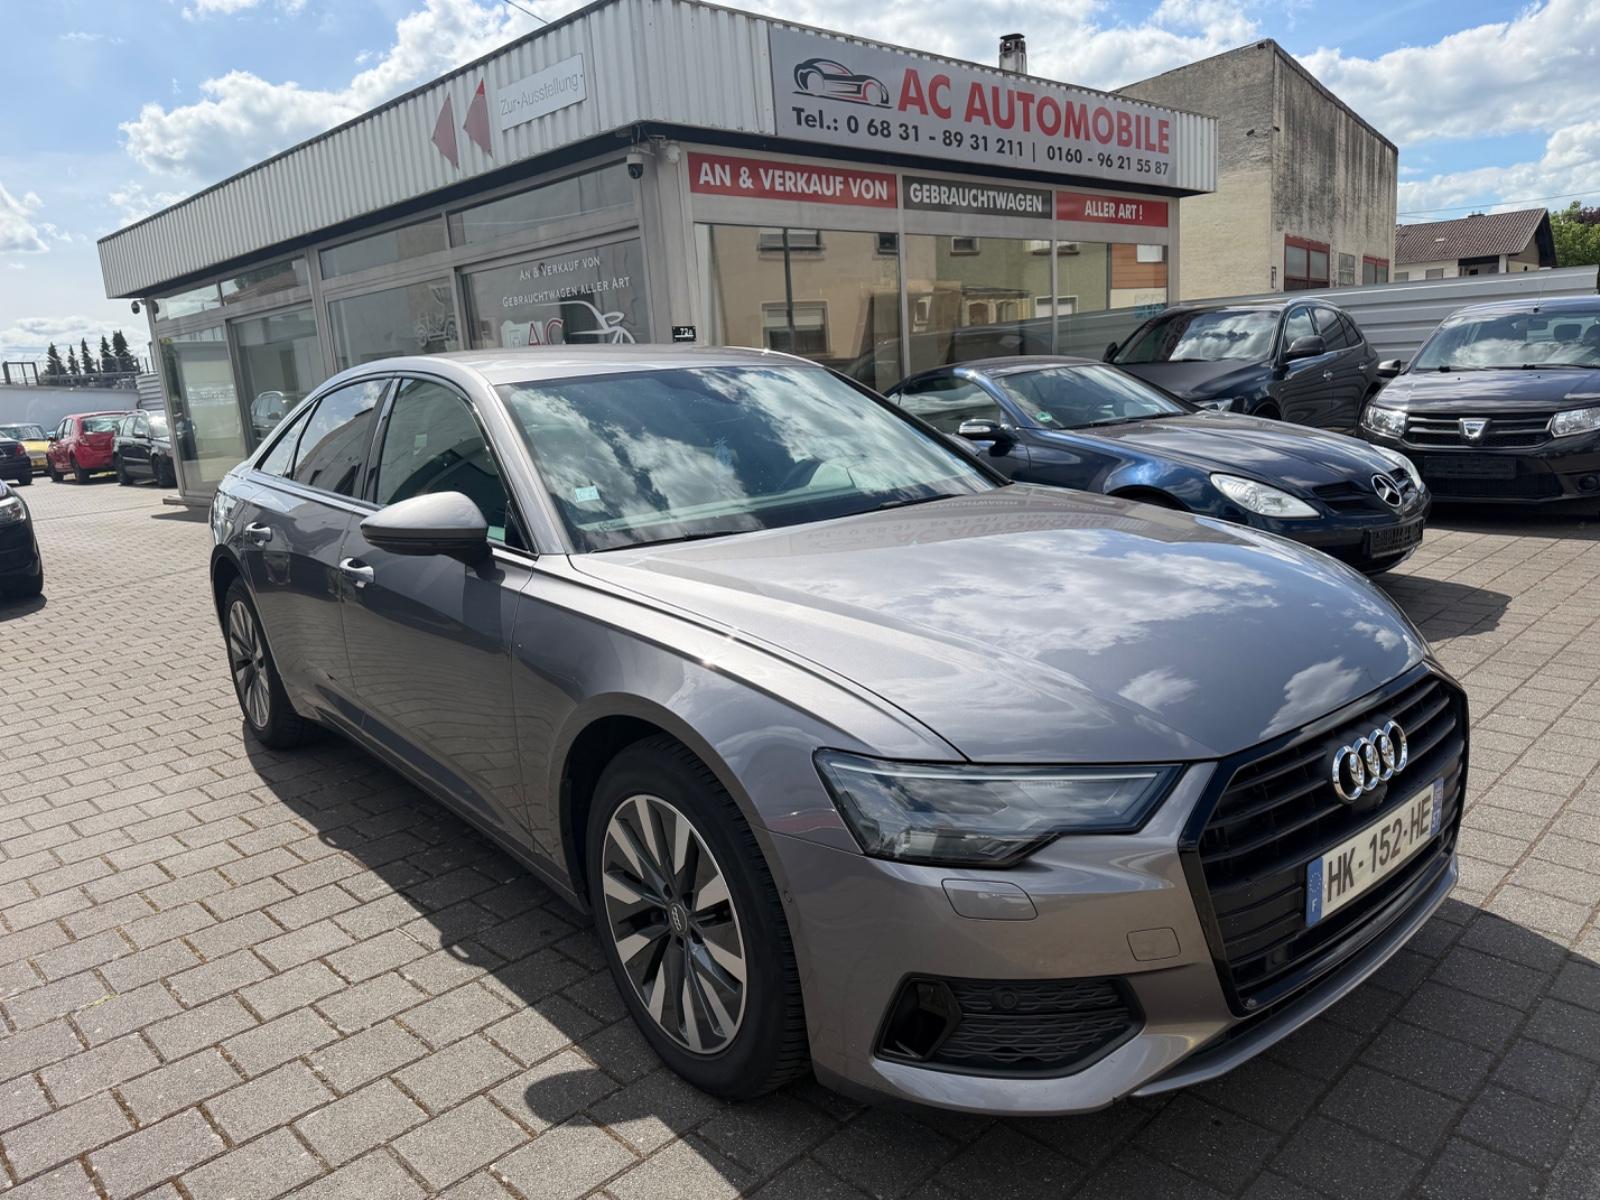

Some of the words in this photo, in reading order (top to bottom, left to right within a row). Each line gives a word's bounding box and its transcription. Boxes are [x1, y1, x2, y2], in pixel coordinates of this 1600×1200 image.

[500, 98, 517, 116] Zur
[521, 73, 578, 108] Ausstellung
[898, 67, 952, 119] AC
[964, 82, 1170, 154] AUTOMOBILE
[792, 106, 838, 131] Tel.:
[847, 115, 859, 134] 0
[867, 118, 891, 138] 68
[899, 123, 919, 142] 31
[942, 129, 963, 147] 89
[970, 134, 988, 152] 31
[996, 138, 1023, 157] 211
[1047, 145, 1082, 164] 0160
[1097, 152, 1113, 168] 96
[1117, 155, 1131, 170] 21
[1137, 159, 1151, 173] 55
[1155, 161, 1169, 176] 87
[699, 162, 731, 187] AN
[739, 166, 754, 189] &
[759, 167, 844, 197] VERKAUF
[848, 176, 888, 200] VON
[910, 182, 1043, 213] GEBRAUCHTWAGEN
[1084, 199, 1116, 219] ALLER
[1117, 203, 1137, 220] ART
[533, 267, 540, 278] &
[582, 256, 601, 269] VON
[580, 280, 608, 294] ALLER
[611, 276, 630, 289] ART
[528, 317, 564, 345] AC
[1311, 898, 1318, 913] F
